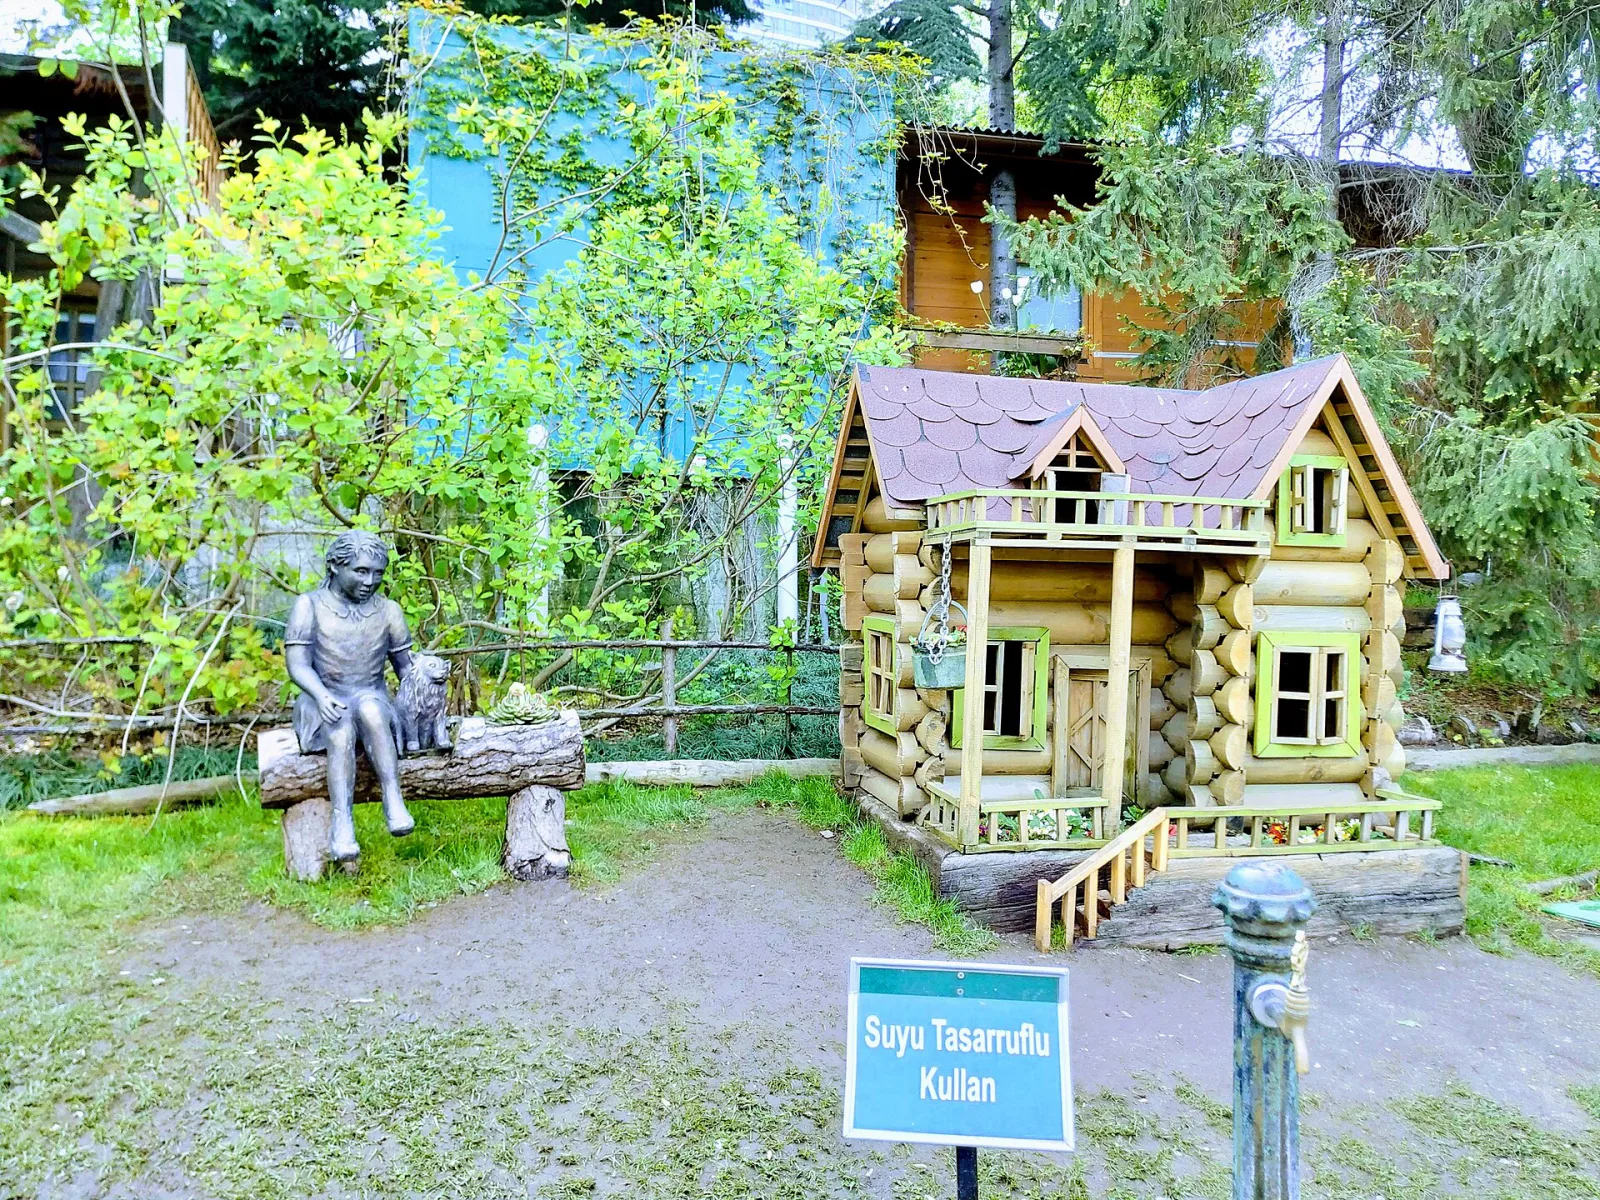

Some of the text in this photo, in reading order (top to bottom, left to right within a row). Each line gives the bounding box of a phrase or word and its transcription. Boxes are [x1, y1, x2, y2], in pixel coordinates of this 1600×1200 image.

[864, 1015, 1050, 1058] Suyu Tasarruflu
[920, 1066, 996, 1103] Kullan
